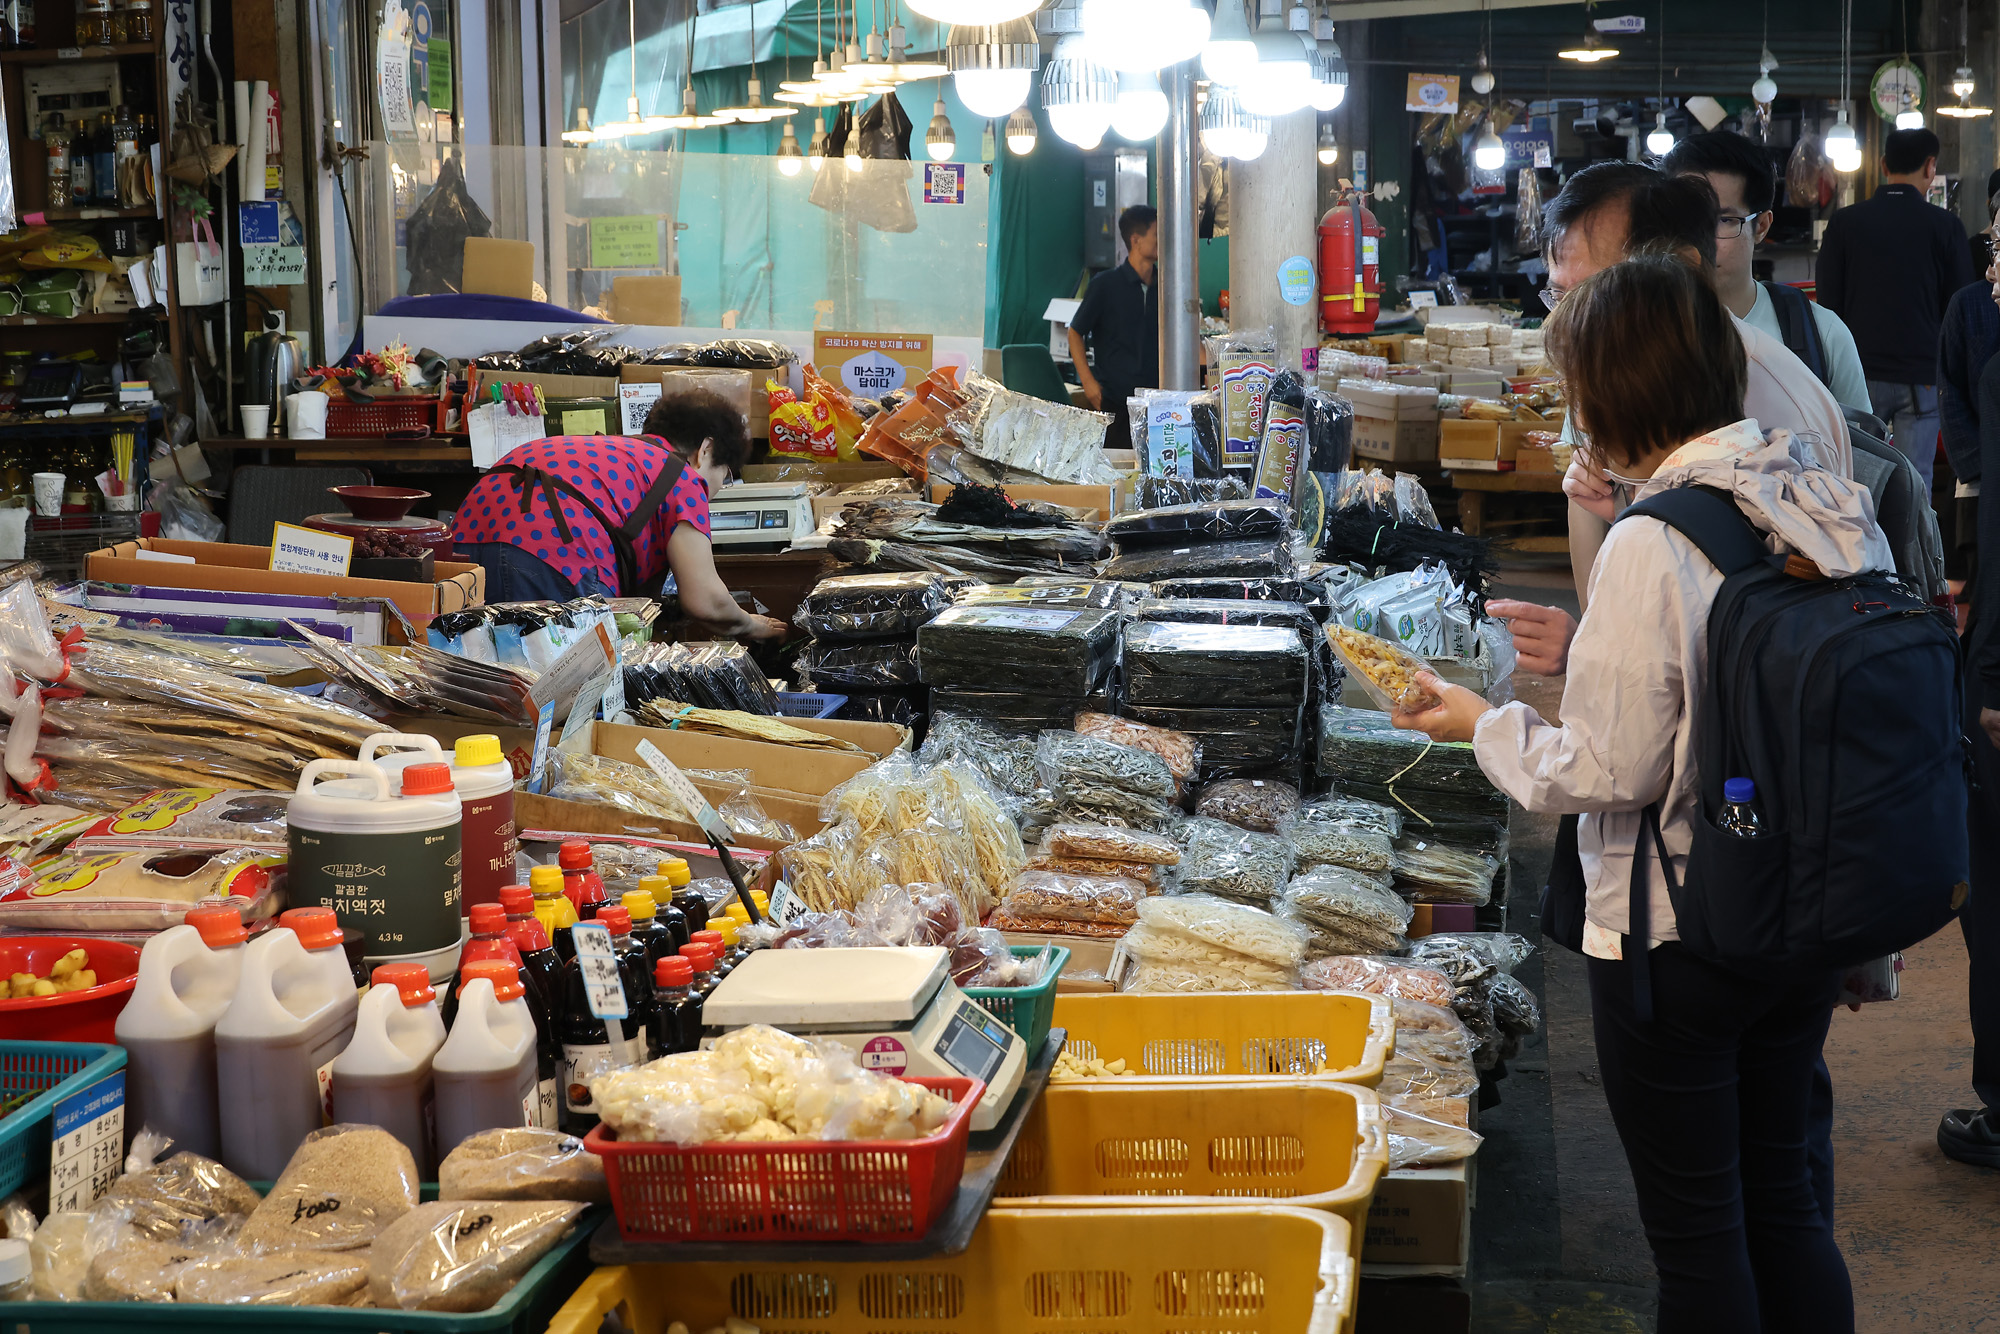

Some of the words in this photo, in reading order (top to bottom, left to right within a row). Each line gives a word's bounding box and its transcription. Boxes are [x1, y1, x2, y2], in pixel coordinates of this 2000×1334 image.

[825, 338, 859, 347] 코로나19
[862, 339, 877, 348] 확산
[880, 340, 903, 349] 방지를
[906, 341, 921, 350] 위해
[854, 366, 895, 377] 마스크가
[859, 377, 889, 388] 답이다
[280, 542, 316, 558] 법정계량단위
[317, 551, 329, 561] 사용
[331, 553, 344, 564] 안내
[335, 884, 368, 896] 깔끔한
[320, 897, 386, 915] 멸치액젓
[393, 932, 403, 943] kg
[96, 1112, 119, 1136] 원산지
